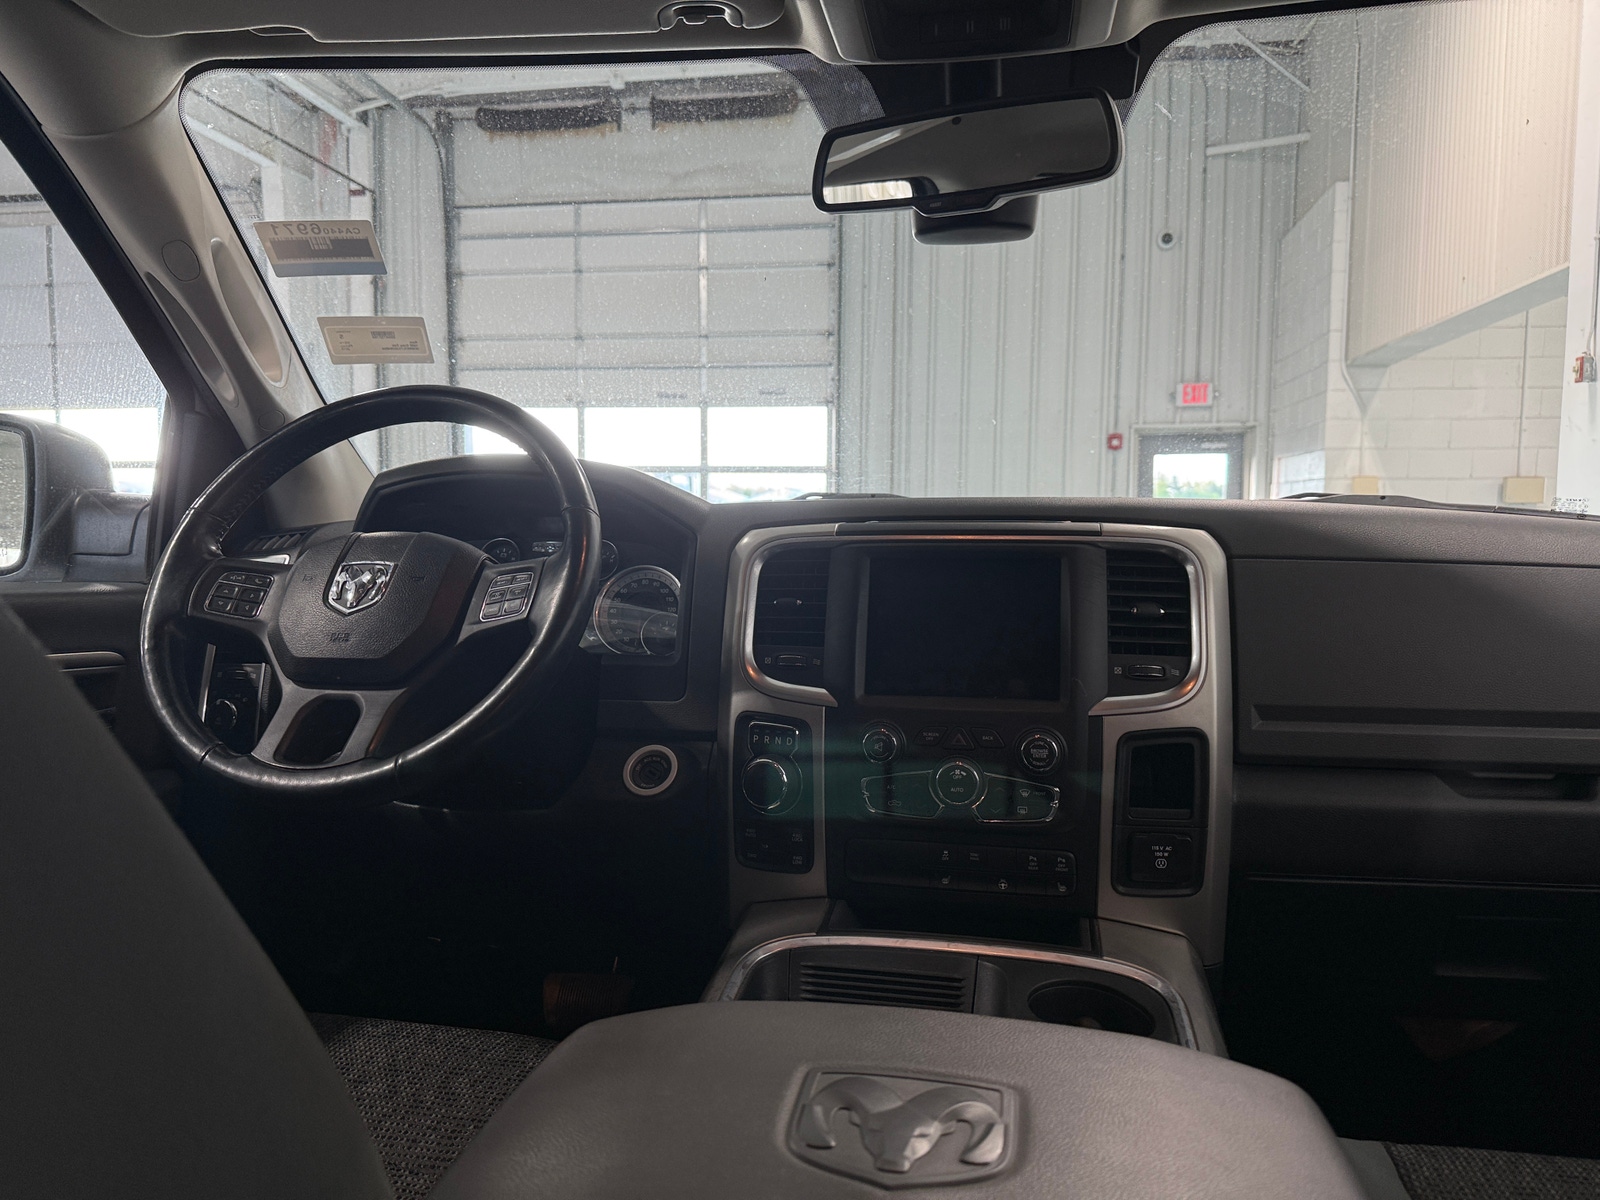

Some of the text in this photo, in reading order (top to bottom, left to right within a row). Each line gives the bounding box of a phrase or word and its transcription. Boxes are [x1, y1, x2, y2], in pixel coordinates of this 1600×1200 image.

[1183, 383, 1208, 404] EXIT
[752, 734, 793, 746] P R N D
